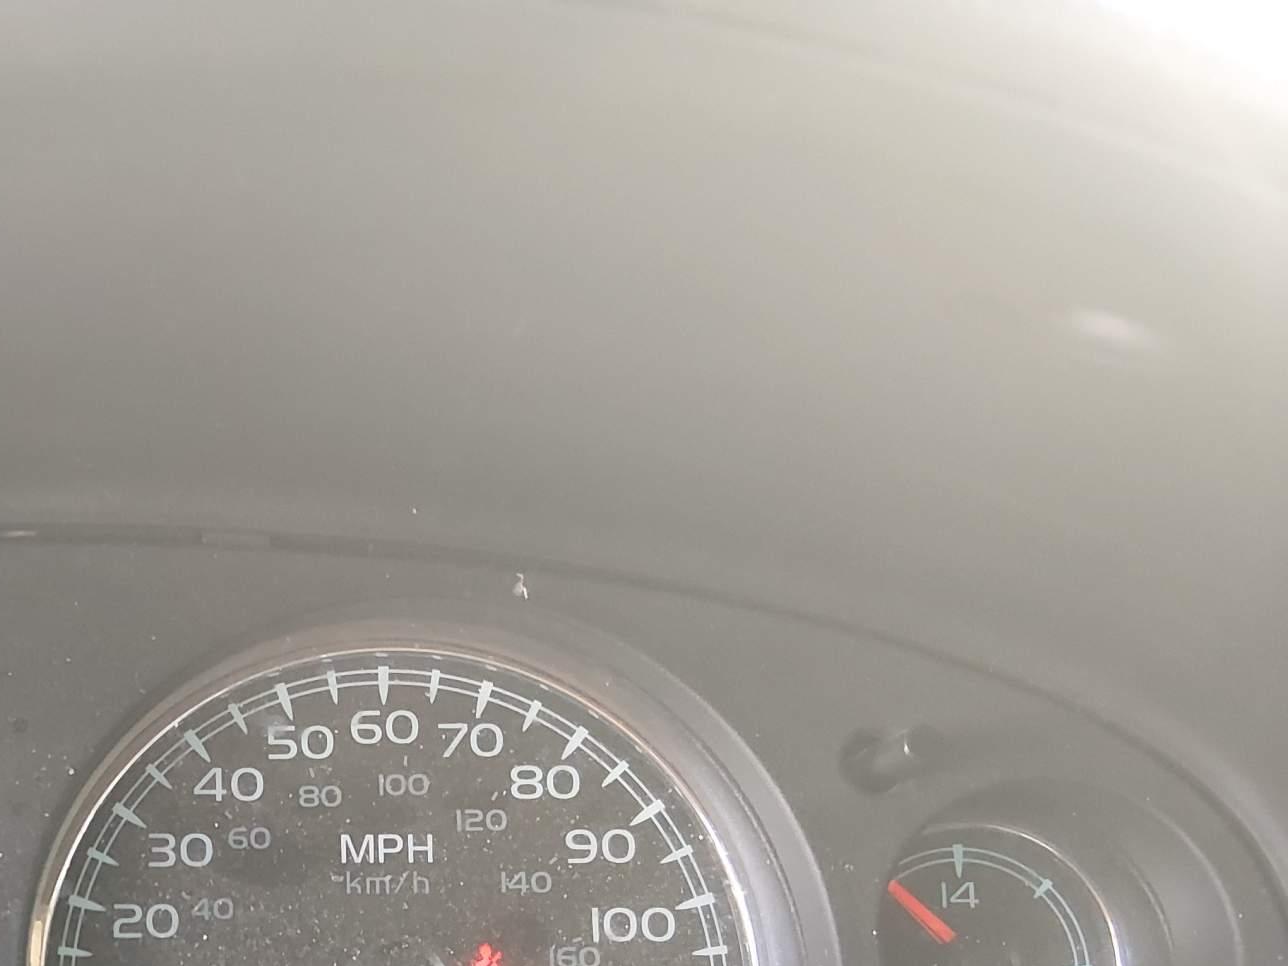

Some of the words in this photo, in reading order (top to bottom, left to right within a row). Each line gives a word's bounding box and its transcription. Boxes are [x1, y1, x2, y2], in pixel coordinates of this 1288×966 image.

[268, 726, 335, 761] 50
[351, 711, 419, 745] 60
[438, 724, 504, 758] 70
[193, 768, 264, 802] 40
[299, 785, 342, 807] 80
[378, 774, 430, 797] 100
[511, 766, 580, 800] 80
[456, 809, 507, 831] 120
[148, 834, 213, 868] 30
[228, 828, 271, 850] 60
[340, 834, 434, 864] MPH
[566, 830, 636, 865] 90
[345, 870, 430, 895] km/h
[500, 871, 552, 893] 140
[940, 881, 979, 909] 14
[113, 904, 179, 939] 20
[192, 899, 234, 921] 40
[592, 908, 677, 943] 100
